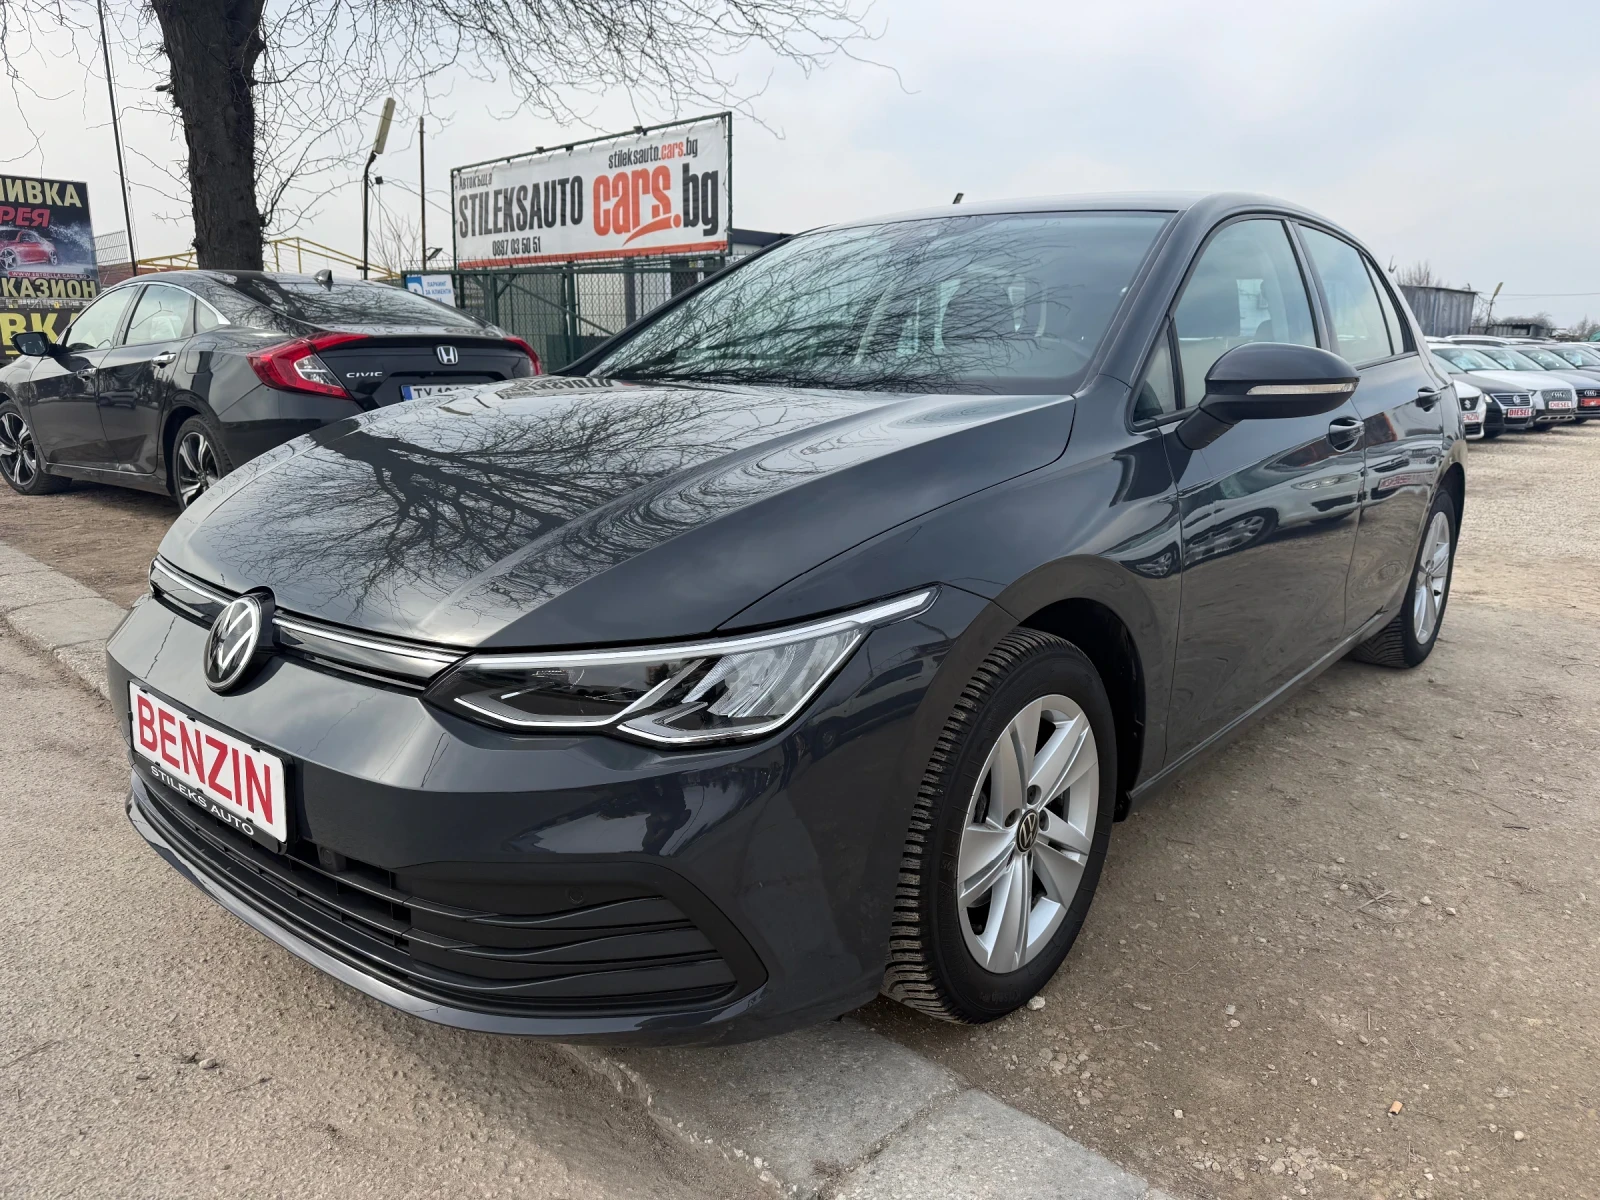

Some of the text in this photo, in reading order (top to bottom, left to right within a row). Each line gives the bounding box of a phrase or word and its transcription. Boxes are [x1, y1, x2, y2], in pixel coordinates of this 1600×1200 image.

[608, 137, 698, 169] stileksauto.cars.bg
[459, 175, 584, 239] STILEKSAUTO
[492, 235, 541, 257] 0897 03 50 51
[0, 312, 78, 346] ВК
[136, 693, 274, 826] BENZIN
[150, 765, 255, 836] STILEKS AUTO
